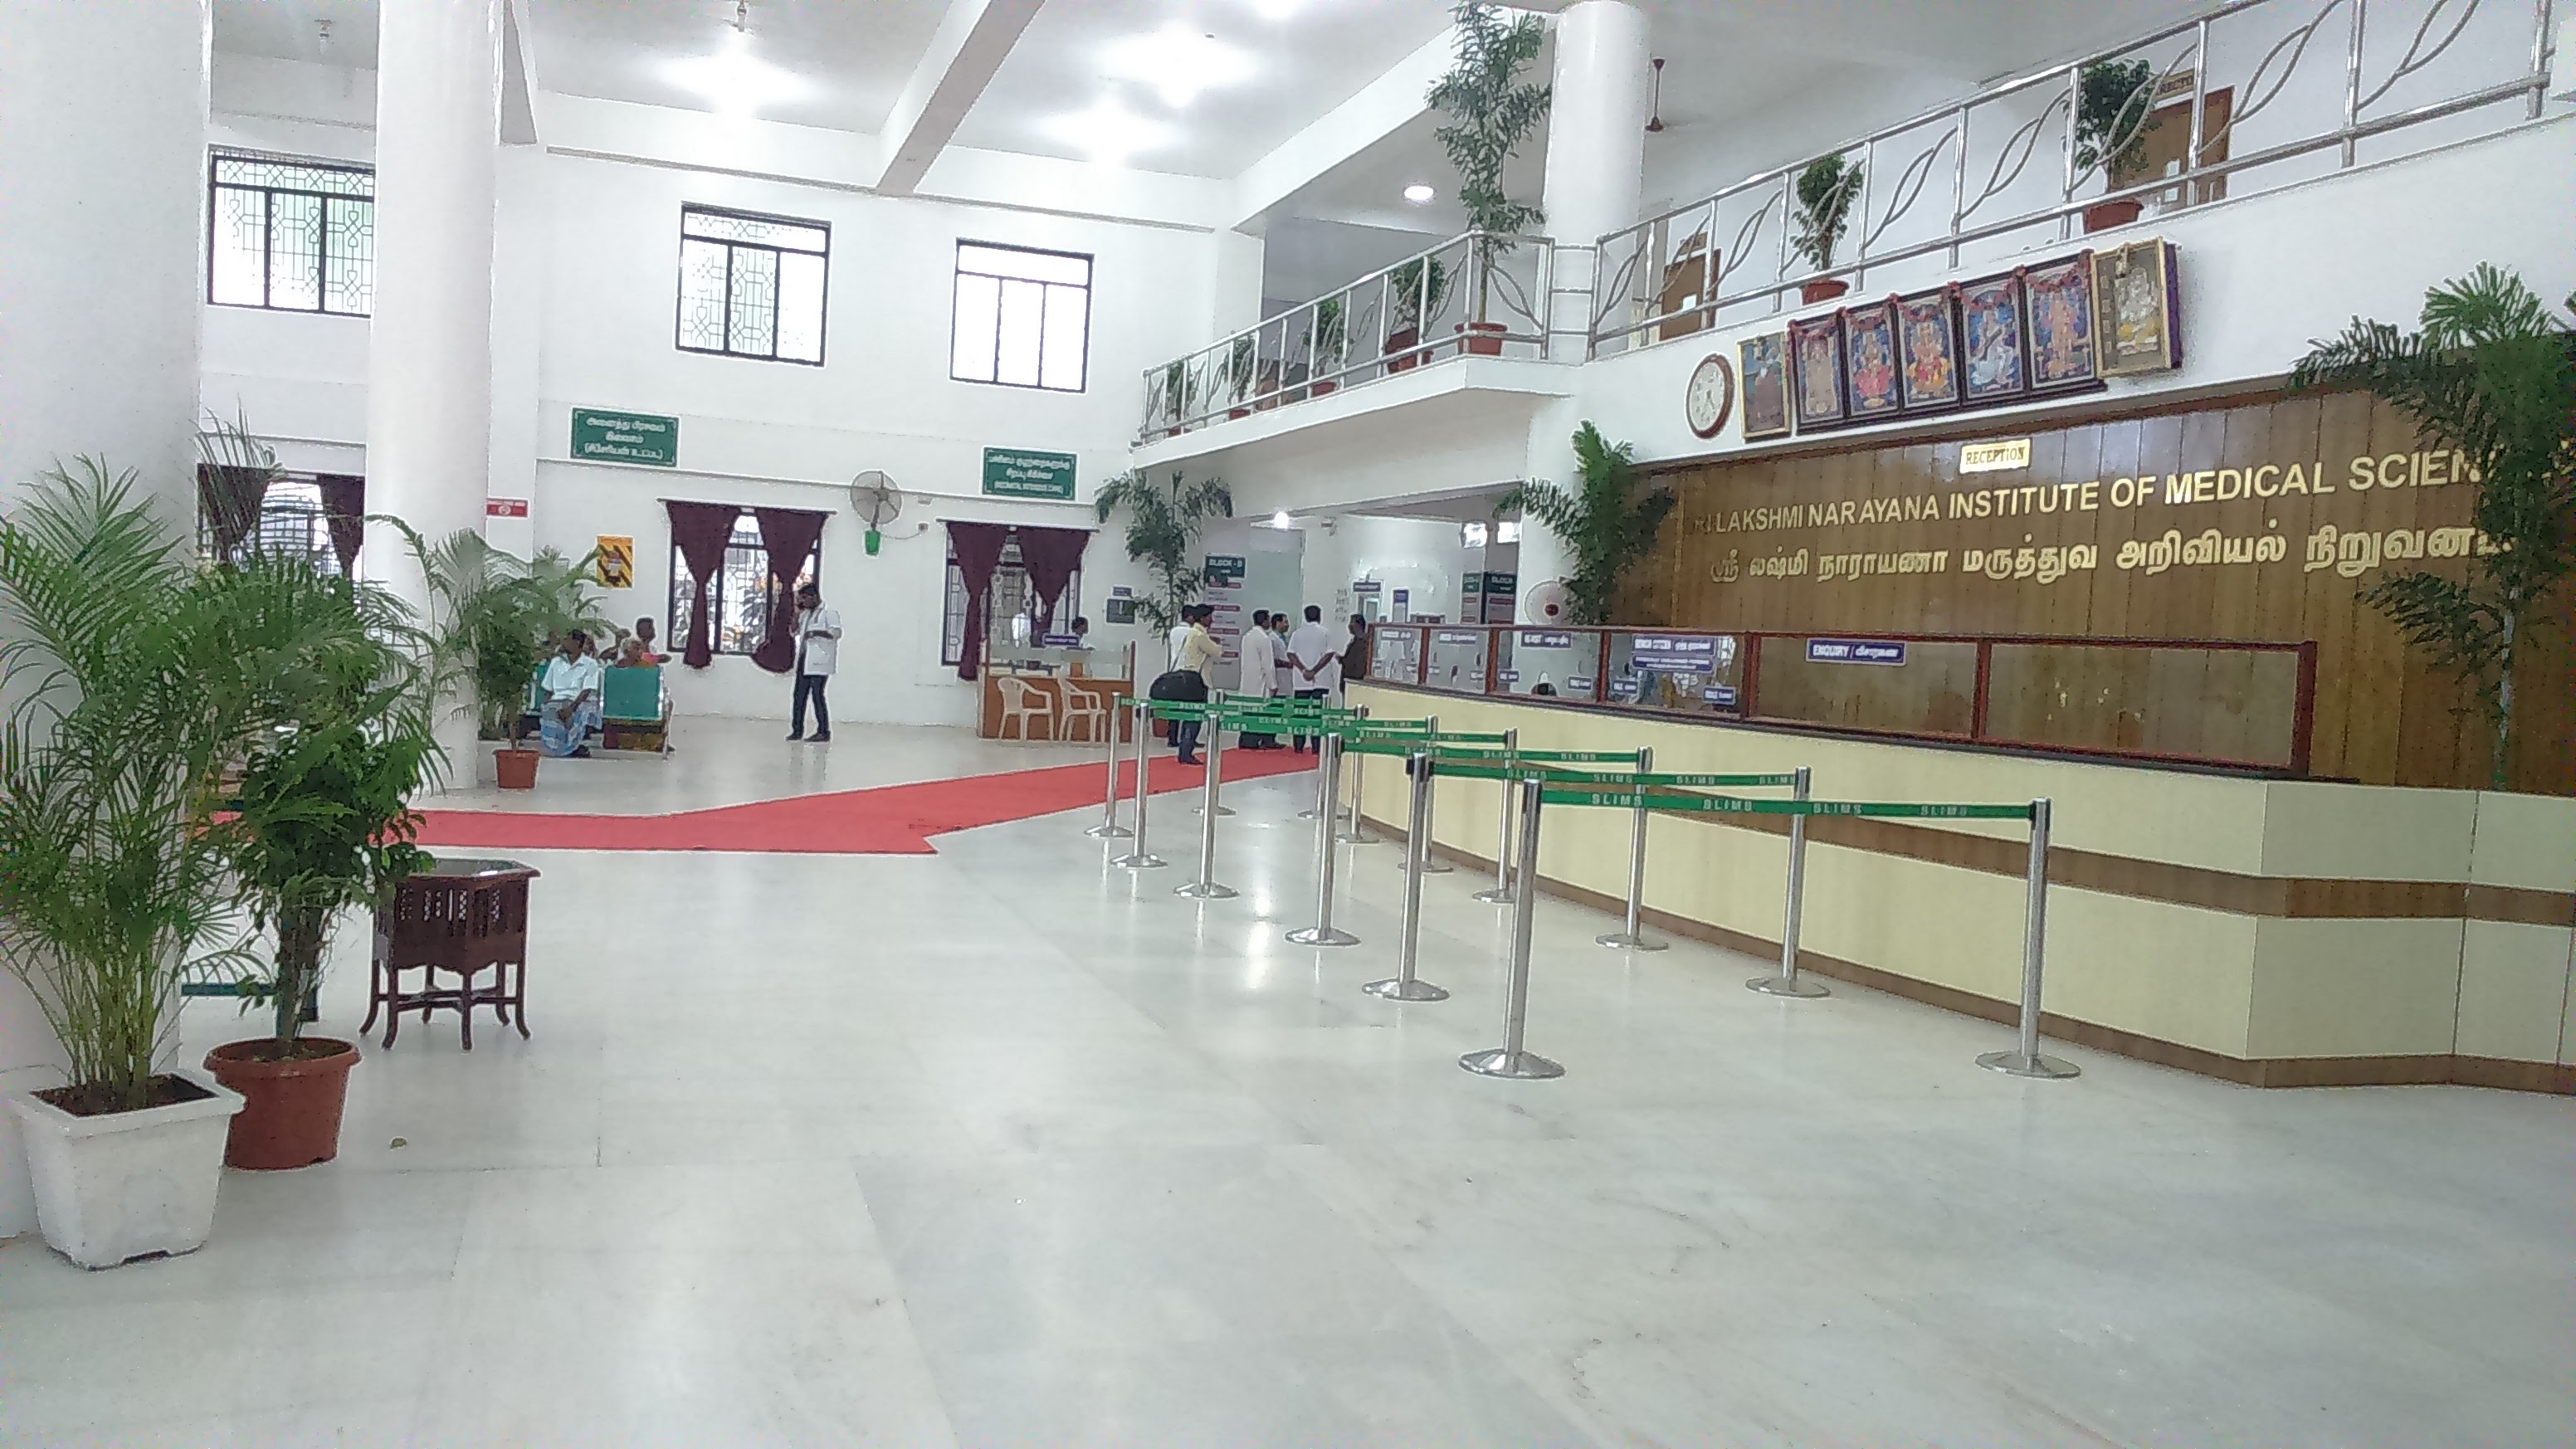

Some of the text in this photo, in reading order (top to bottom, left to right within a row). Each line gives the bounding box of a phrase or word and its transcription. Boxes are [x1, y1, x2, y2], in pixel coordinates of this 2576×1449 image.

[1965, 446, 2025, 465] RECEPTION
[1715, 504, 1804, 533] LAKSHMI
[1808, 494, 1940, 527] NARAYANA
[1948, 481, 2100, 520] INSTITUTE
[2109, 476, 2157, 509] OF
[2164, 461, 2336, 505] MEDICAL
[1817, 549, 1949, 583] நாராயணா
[1962, 533, 2099, 584] மருத்துவ
[2115, 517, 2287, 577] அறிவியல்
[1593, 773, 1633, 784] SLIMS
[1676, 774, 1715, 785] SLIMS
[1592, 793, 1967, 817] SLIMS SLIMS SLIMS SLIMS
